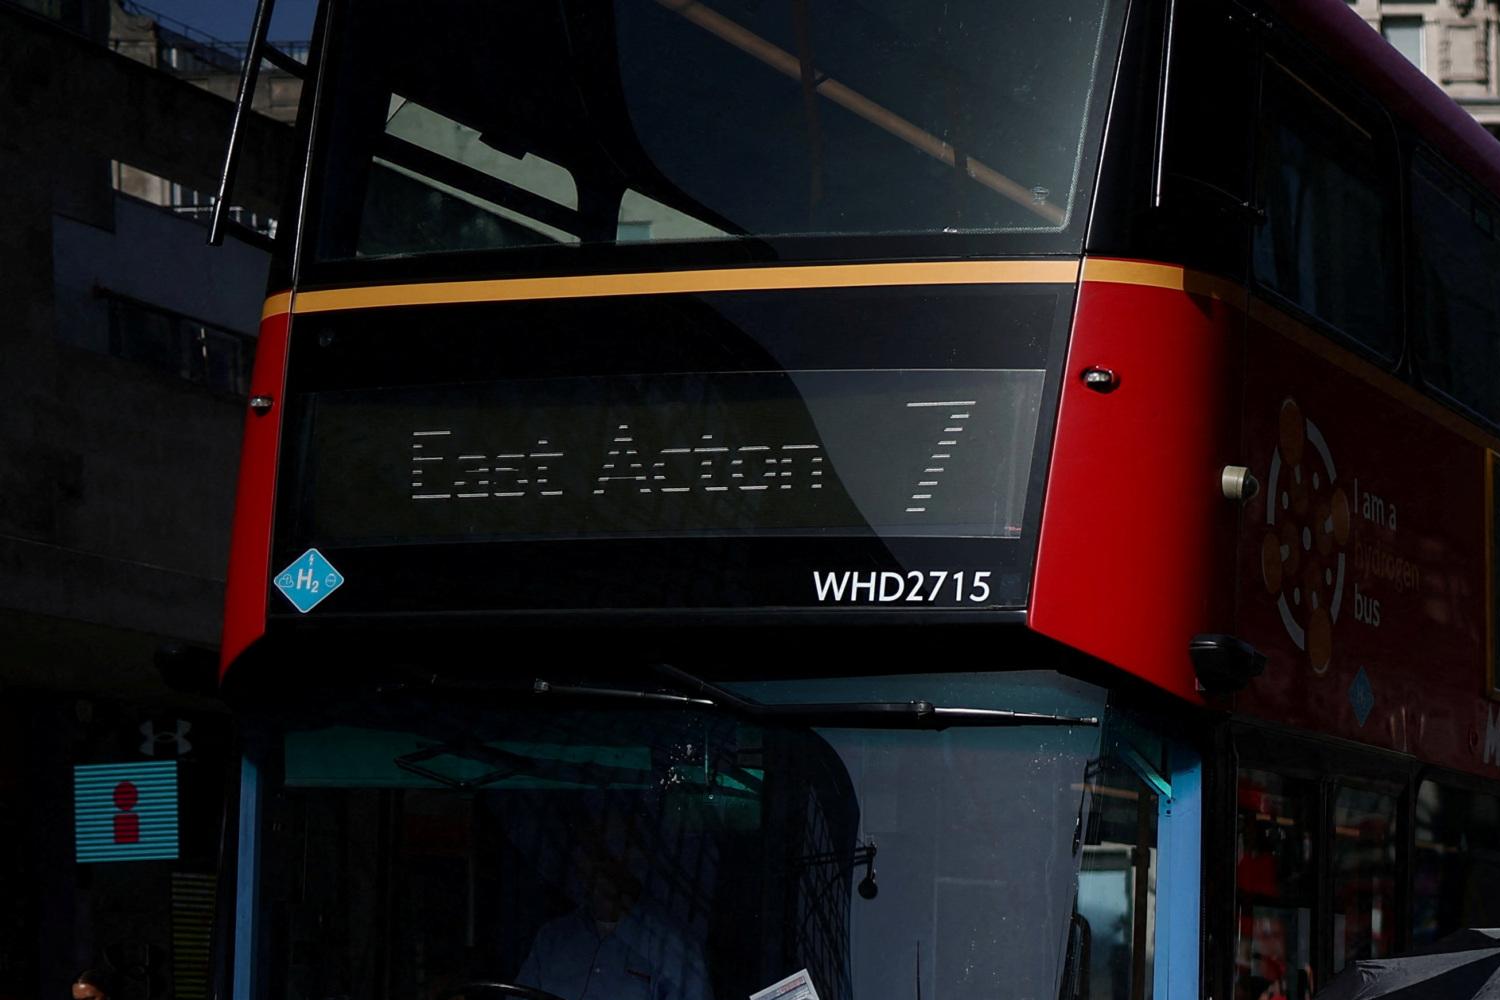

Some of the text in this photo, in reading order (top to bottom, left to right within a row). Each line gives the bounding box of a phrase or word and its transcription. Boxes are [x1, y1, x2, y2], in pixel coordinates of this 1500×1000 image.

[412, 400, 977, 512] East Acton 7
[1353, 477, 1398, 532] I am a
[296, 568, 320, 593] H2
[812, 570, 992, 602] WHD2715
[1353, 529, 1422, 594] hydrogen
[1354, 582, 1381, 627] bus
